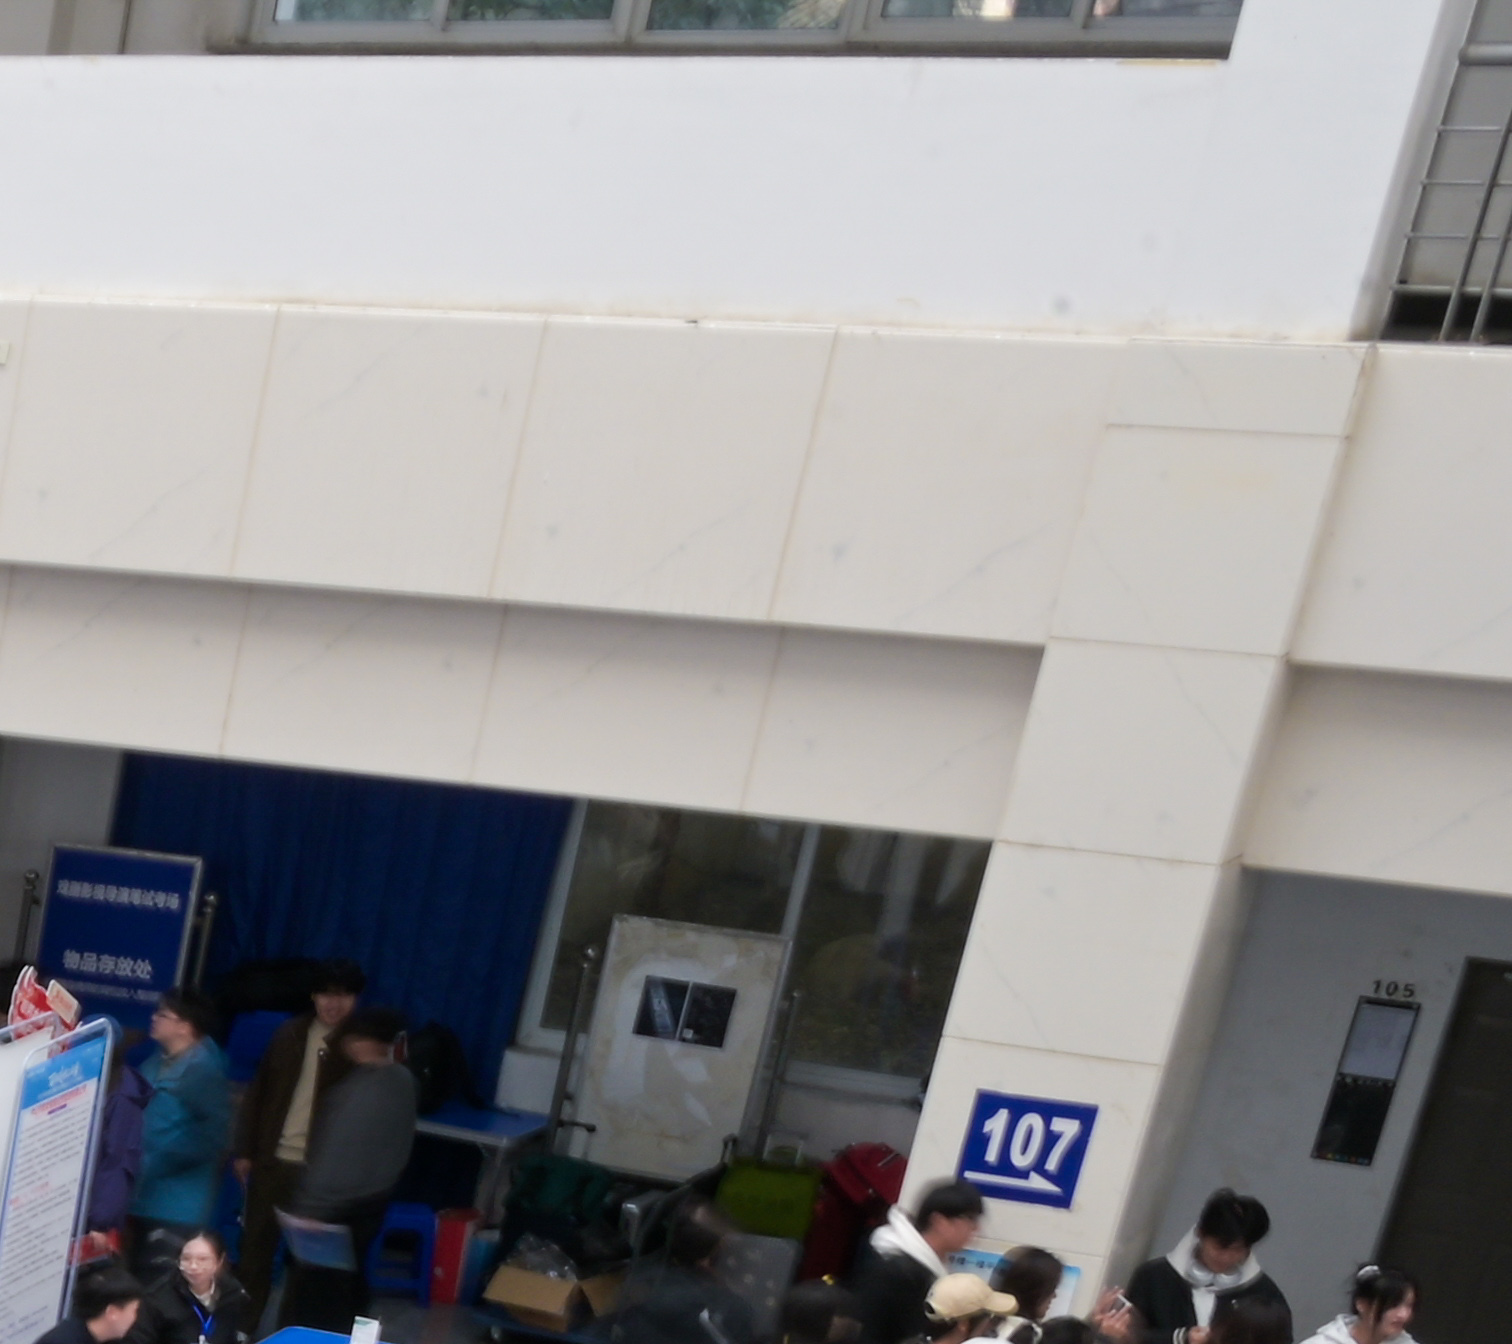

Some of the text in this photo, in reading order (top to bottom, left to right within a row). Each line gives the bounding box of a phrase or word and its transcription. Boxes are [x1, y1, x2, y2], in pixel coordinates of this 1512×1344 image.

[63, 949, 152, 980] 物品存放处
[1371, 979, 1417, 999] 105
[980, 1107, 1082, 1173] 107
